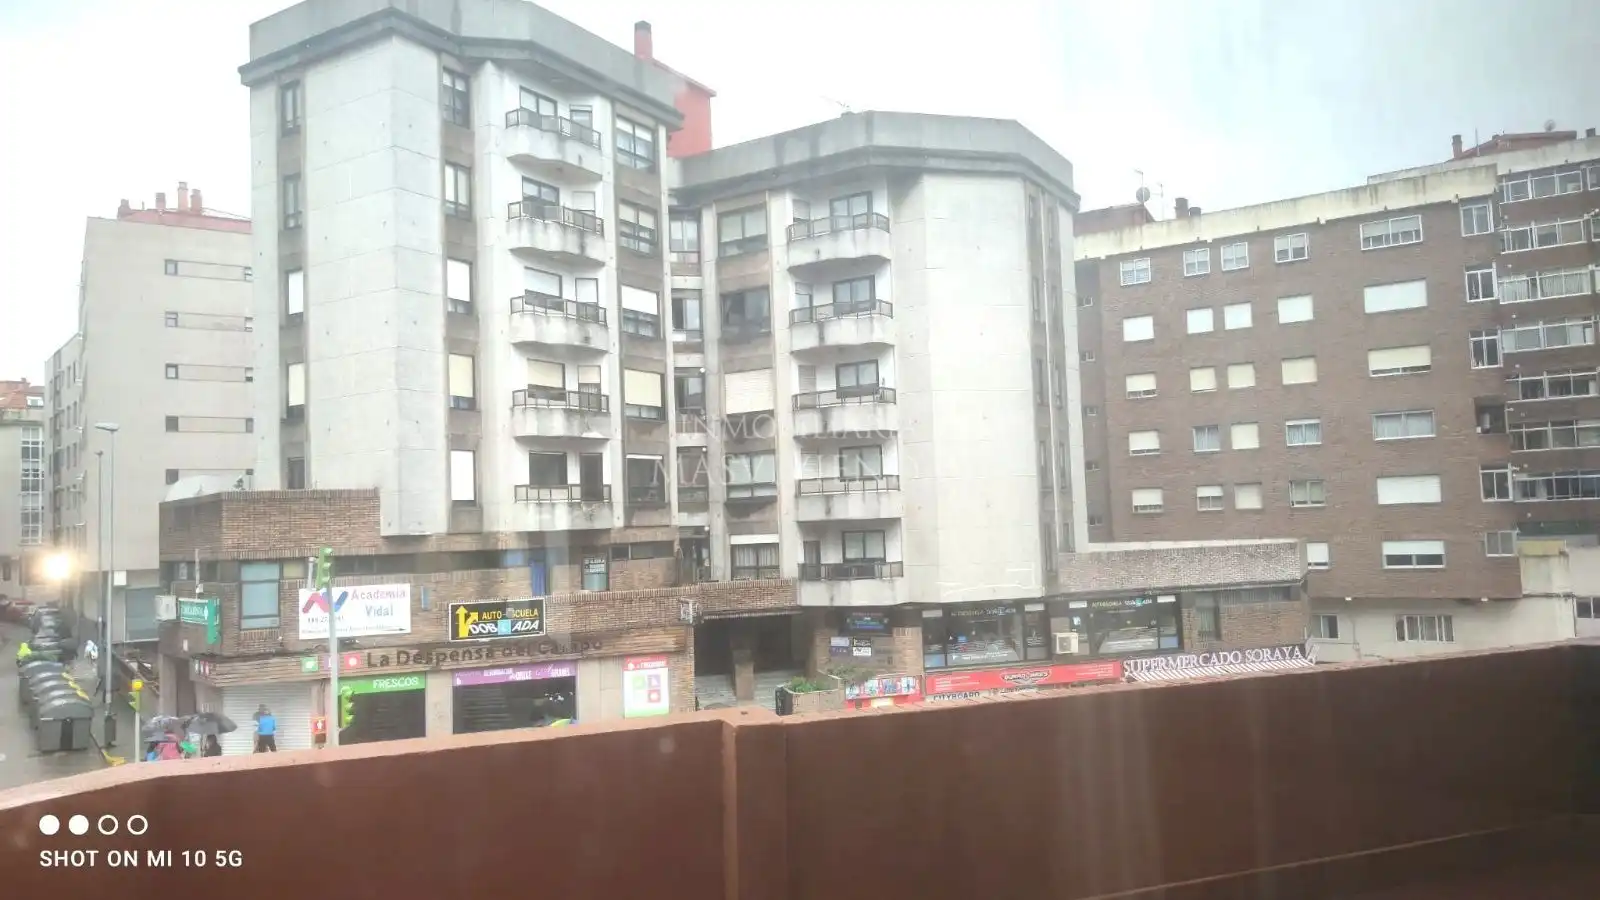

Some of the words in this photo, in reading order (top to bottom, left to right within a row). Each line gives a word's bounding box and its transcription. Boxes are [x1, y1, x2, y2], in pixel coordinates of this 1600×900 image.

[350, 588, 406, 601] Academia
[365, 603, 394, 617] Vidal
[367, 652, 389, 668] La
[396, 646, 496, 667] Despensa
[1122, 650, 1243, 674] SUPERMERCADO
[1245, 645, 1303, 663] SORAYA
[372, 676, 420, 690] FRESCOS
